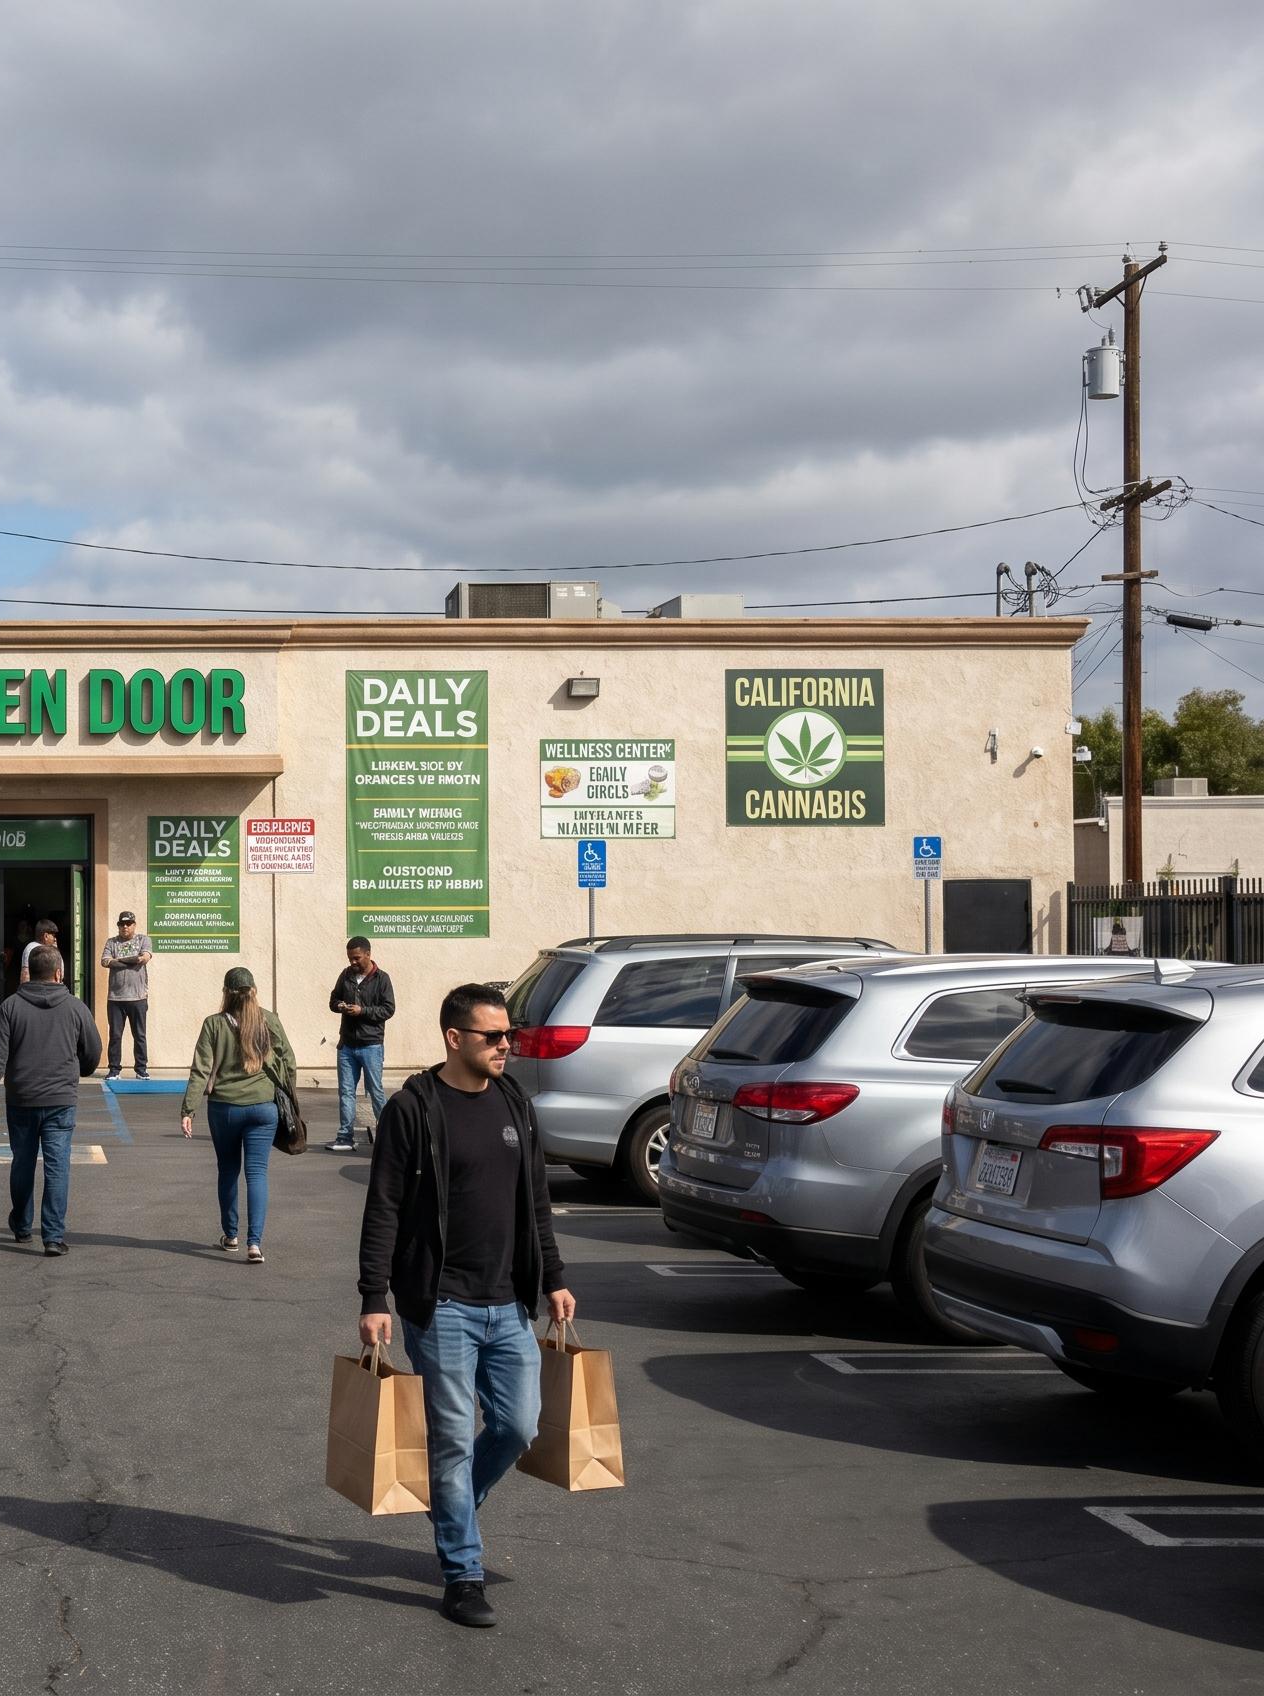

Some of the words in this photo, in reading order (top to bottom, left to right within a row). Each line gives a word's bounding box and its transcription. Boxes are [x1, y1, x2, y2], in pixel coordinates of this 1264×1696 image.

[88, 668, 247, 736] DOOR
[362, 678, 471, 705] DAILY
[734, 677, 875, 707] CALIFORNIA
[355, 709, 478, 738] DEALS
[545, 743, 612, 758] WELLNESS
[744, 789, 867, 819] CANNABIS
[159, 820, 227, 838] DAILY
[155, 840, 231, 857] DEALS
